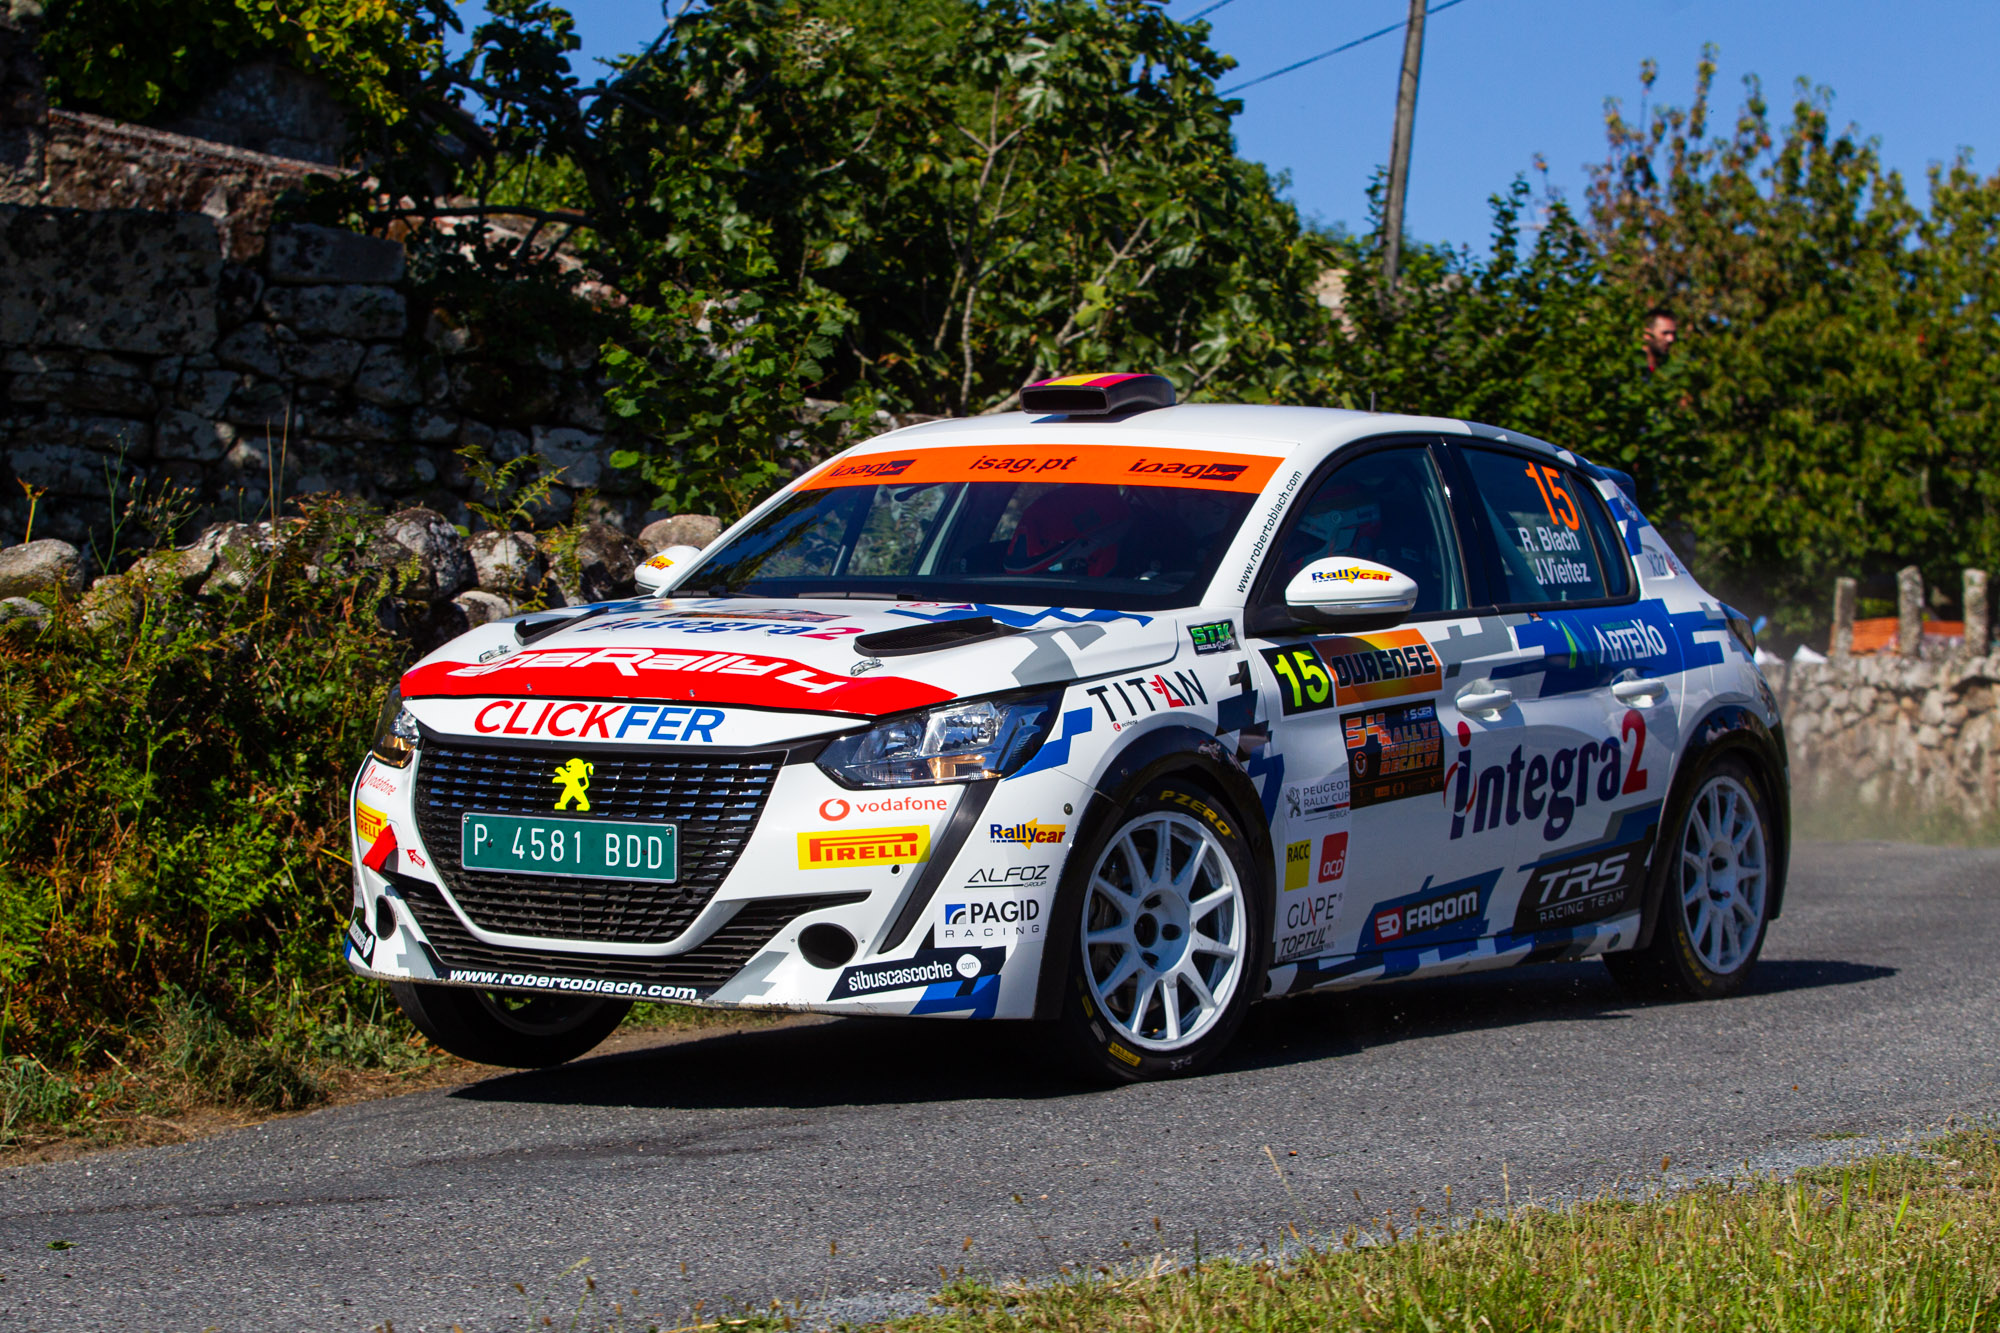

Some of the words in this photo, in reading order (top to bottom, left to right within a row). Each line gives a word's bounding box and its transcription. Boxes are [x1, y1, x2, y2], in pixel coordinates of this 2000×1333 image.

[968, 454, 1078, 474] isag.pt
[1525, 461, 1580, 531] 15
[1237, 469, 1303, 594] www.robertoblach.com
[1518, 527, 1539, 552] R.
[1540, 525, 1581, 551] Blach
[1312, 569, 1393, 584] Rallycar
[1594, 619, 1667, 664] ARTEIXO
[1274, 651, 1330, 707] 15
[1332, 645, 1437, 687] OURENSE
[1086, 668, 1208, 722] TITAN
[474, 700, 725, 743] CLICKFER
[1303, 779, 1350, 797] PEUGEOT
[1303, 794, 1330, 808] RALLY
[856, 796, 947, 813] vodafone
[474, 824, 488, 856] P
[512, 827, 582, 864] 4581
[605, 834, 663, 869] BDD
[809, 832, 918, 862] PIRELLI
[990, 824, 1066, 843] Rallycar
[1287, 844, 1310, 863] RACC
[1323, 859, 1343, 877] acp
[968, 865, 1050, 883] ALFOZ
[1538, 852, 1630, 905] TRS
[970, 899, 1039, 924] PAGID
[1406, 892, 1478, 932] FACOM
[1539, 902, 1584, 924] RACING
[1591, 891, 1625, 909] TEAM
[945, 925, 1040, 938] RACING
[1280, 927, 1325, 955] TOPTUL
[450, 969, 697, 1000] www.robertoblach.com
[848, 960, 953, 991] sibuscascoche
